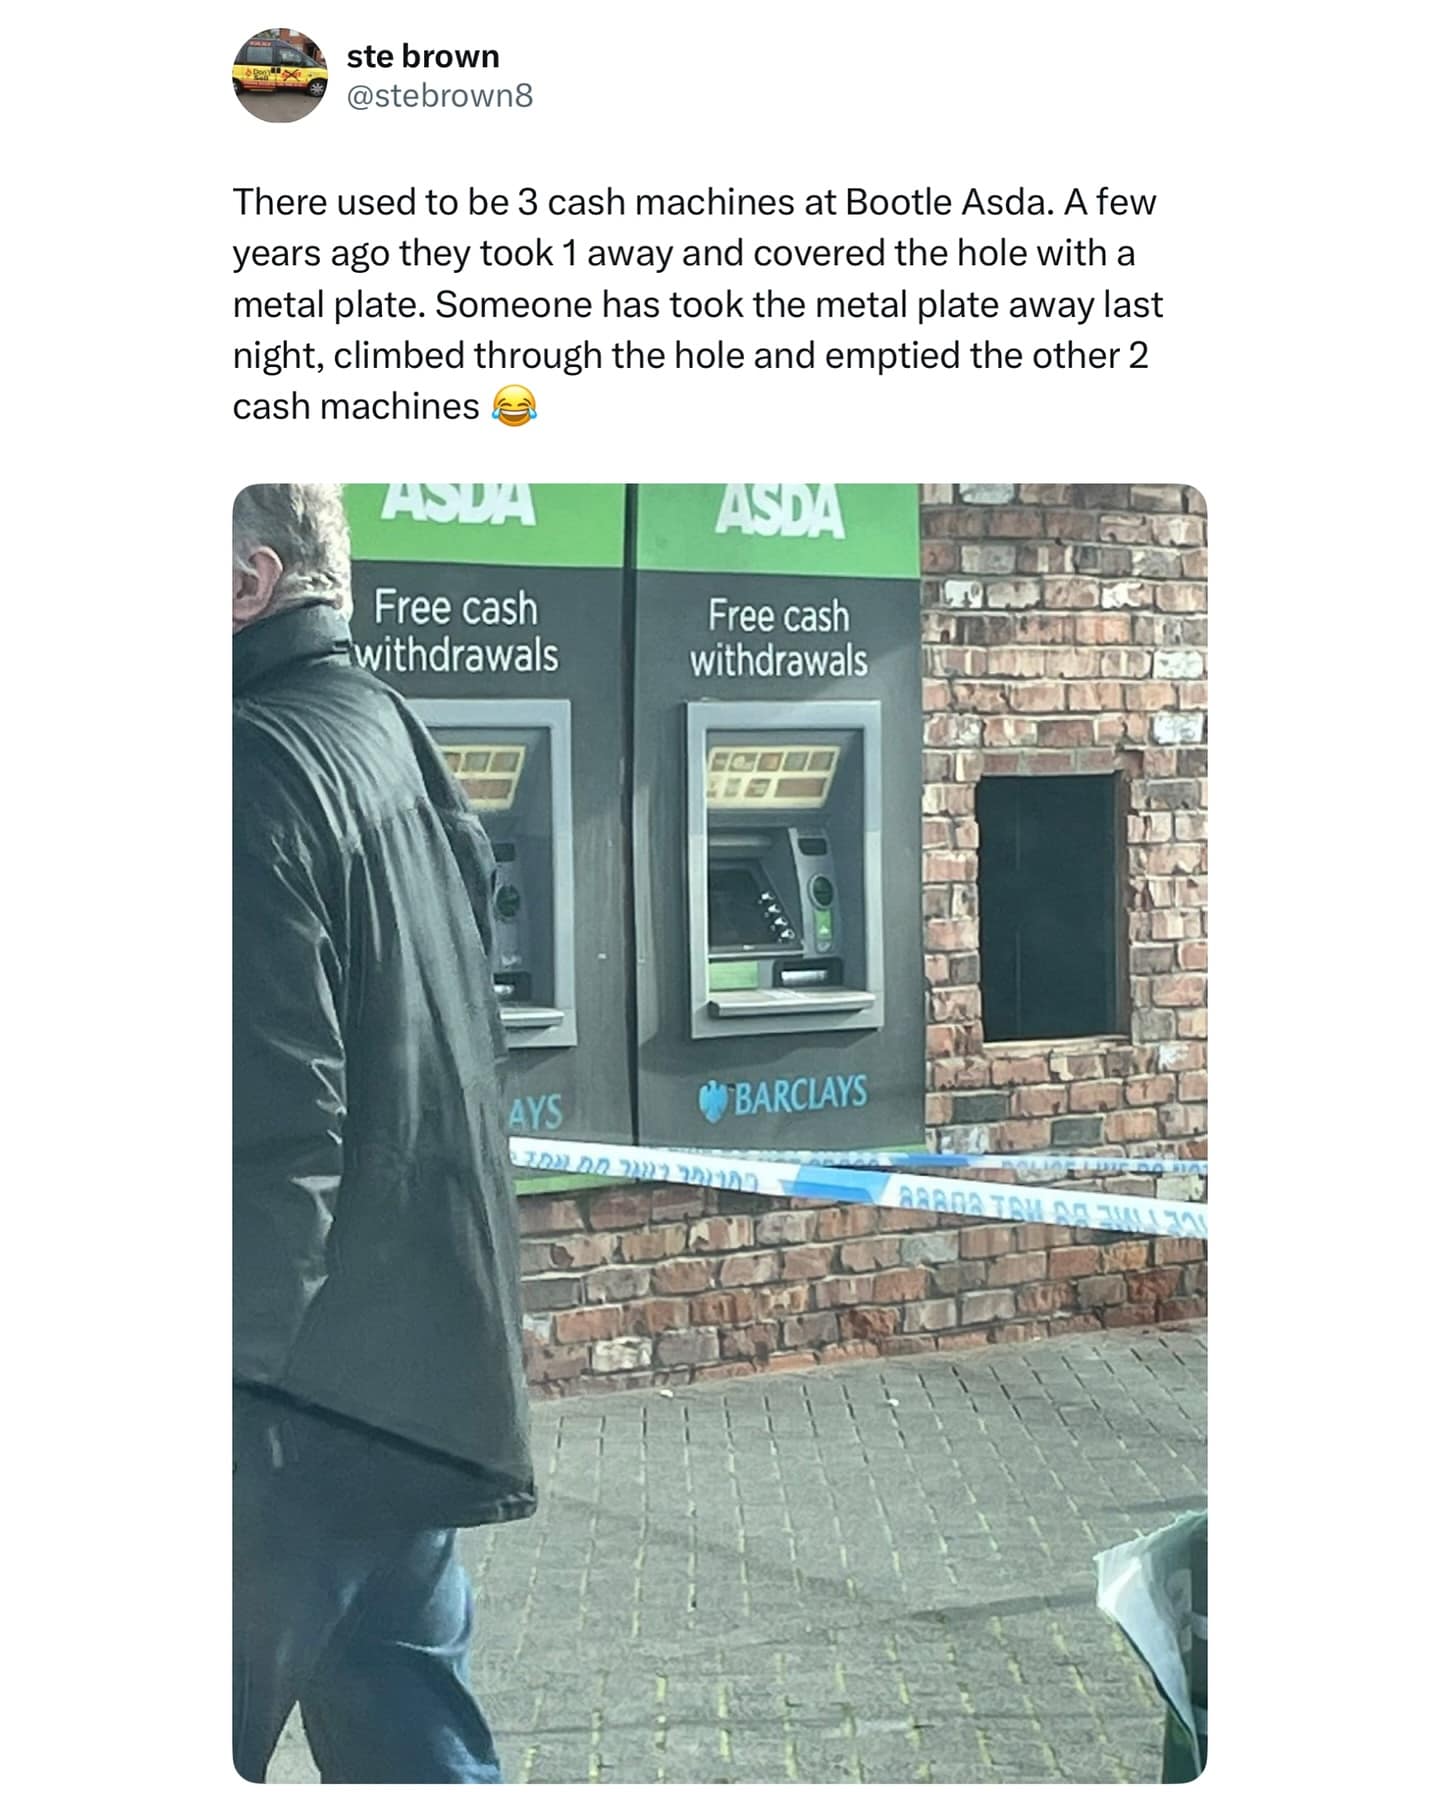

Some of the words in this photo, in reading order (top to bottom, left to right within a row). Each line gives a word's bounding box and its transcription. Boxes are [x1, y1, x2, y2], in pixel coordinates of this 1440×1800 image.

[381, 483, 537, 526] ASDA
[714, 483, 846, 540] ASDA
[375, 588, 451, 625] Free
[462, 589, 538, 625] cash
[709, 597, 775, 633] Free
[783, 598, 850, 632] cash
[355, 635, 560, 673] withdrawals
[690, 641, 869, 678] withdrawals
[734, 1073, 869, 1116] BARCLAYS
